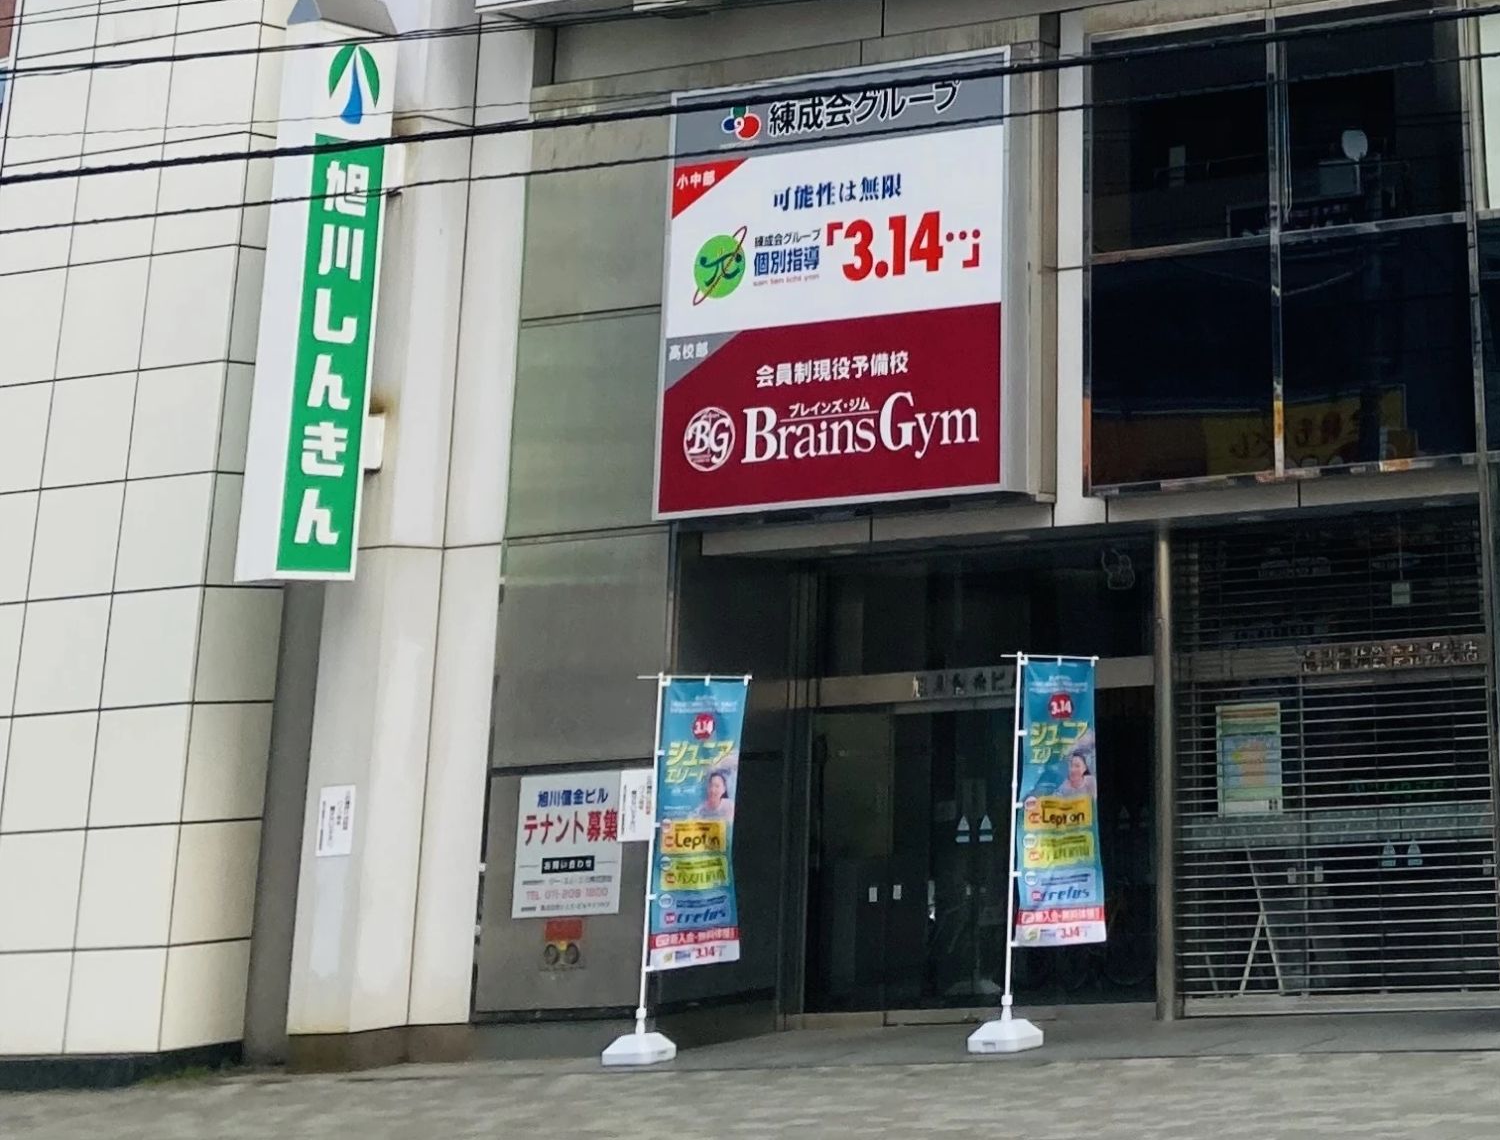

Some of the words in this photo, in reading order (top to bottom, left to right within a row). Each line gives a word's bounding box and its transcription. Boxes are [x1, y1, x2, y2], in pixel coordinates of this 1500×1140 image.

[768, 77, 963, 136] 練成会グループ
[675, 169, 717, 191] 小中部
[772, 173, 902, 212] 可能性は無限
[754, 228, 822, 248] 練成会グループ
[753, 245, 821, 277] 個別指導
[293, 160, 371, 546] 旭川しんきん
[668, 341, 709, 362] 高校部
[755, 350, 910, 389] 会員制現役予備校
[789, 397, 871, 419] ブレインズ・ジム
[666, 740, 735, 766] ジュニア
[537, 787, 610, 808] 旭川信金ビル
[523, 808, 619, 846] テナント募集
